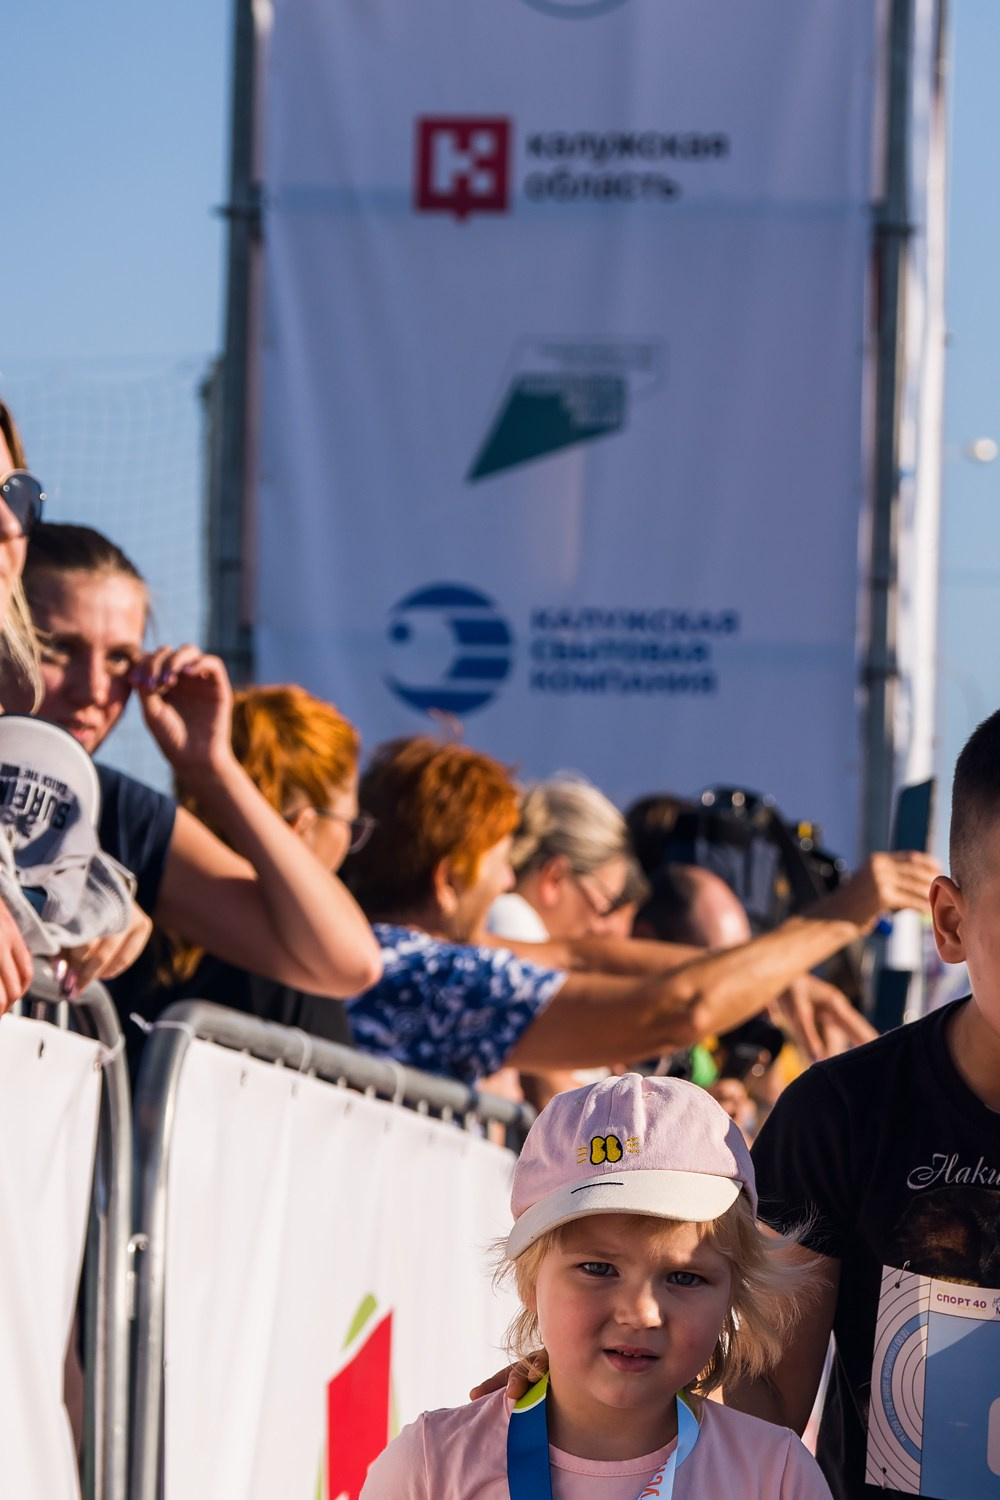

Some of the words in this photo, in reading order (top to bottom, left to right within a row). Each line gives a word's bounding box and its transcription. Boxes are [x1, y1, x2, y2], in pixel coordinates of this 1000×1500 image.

[526, 131, 731, 166] калужская
[525, 163, 682, 203] область
[533, 607, 740, 634] КАЛУЖСКАЯ
[531, 668, 718, 694] КОМПАНИЯ
[936, 1293, 972, 1307] СПОРТ
[973, 1300, 987, 1309] 40
